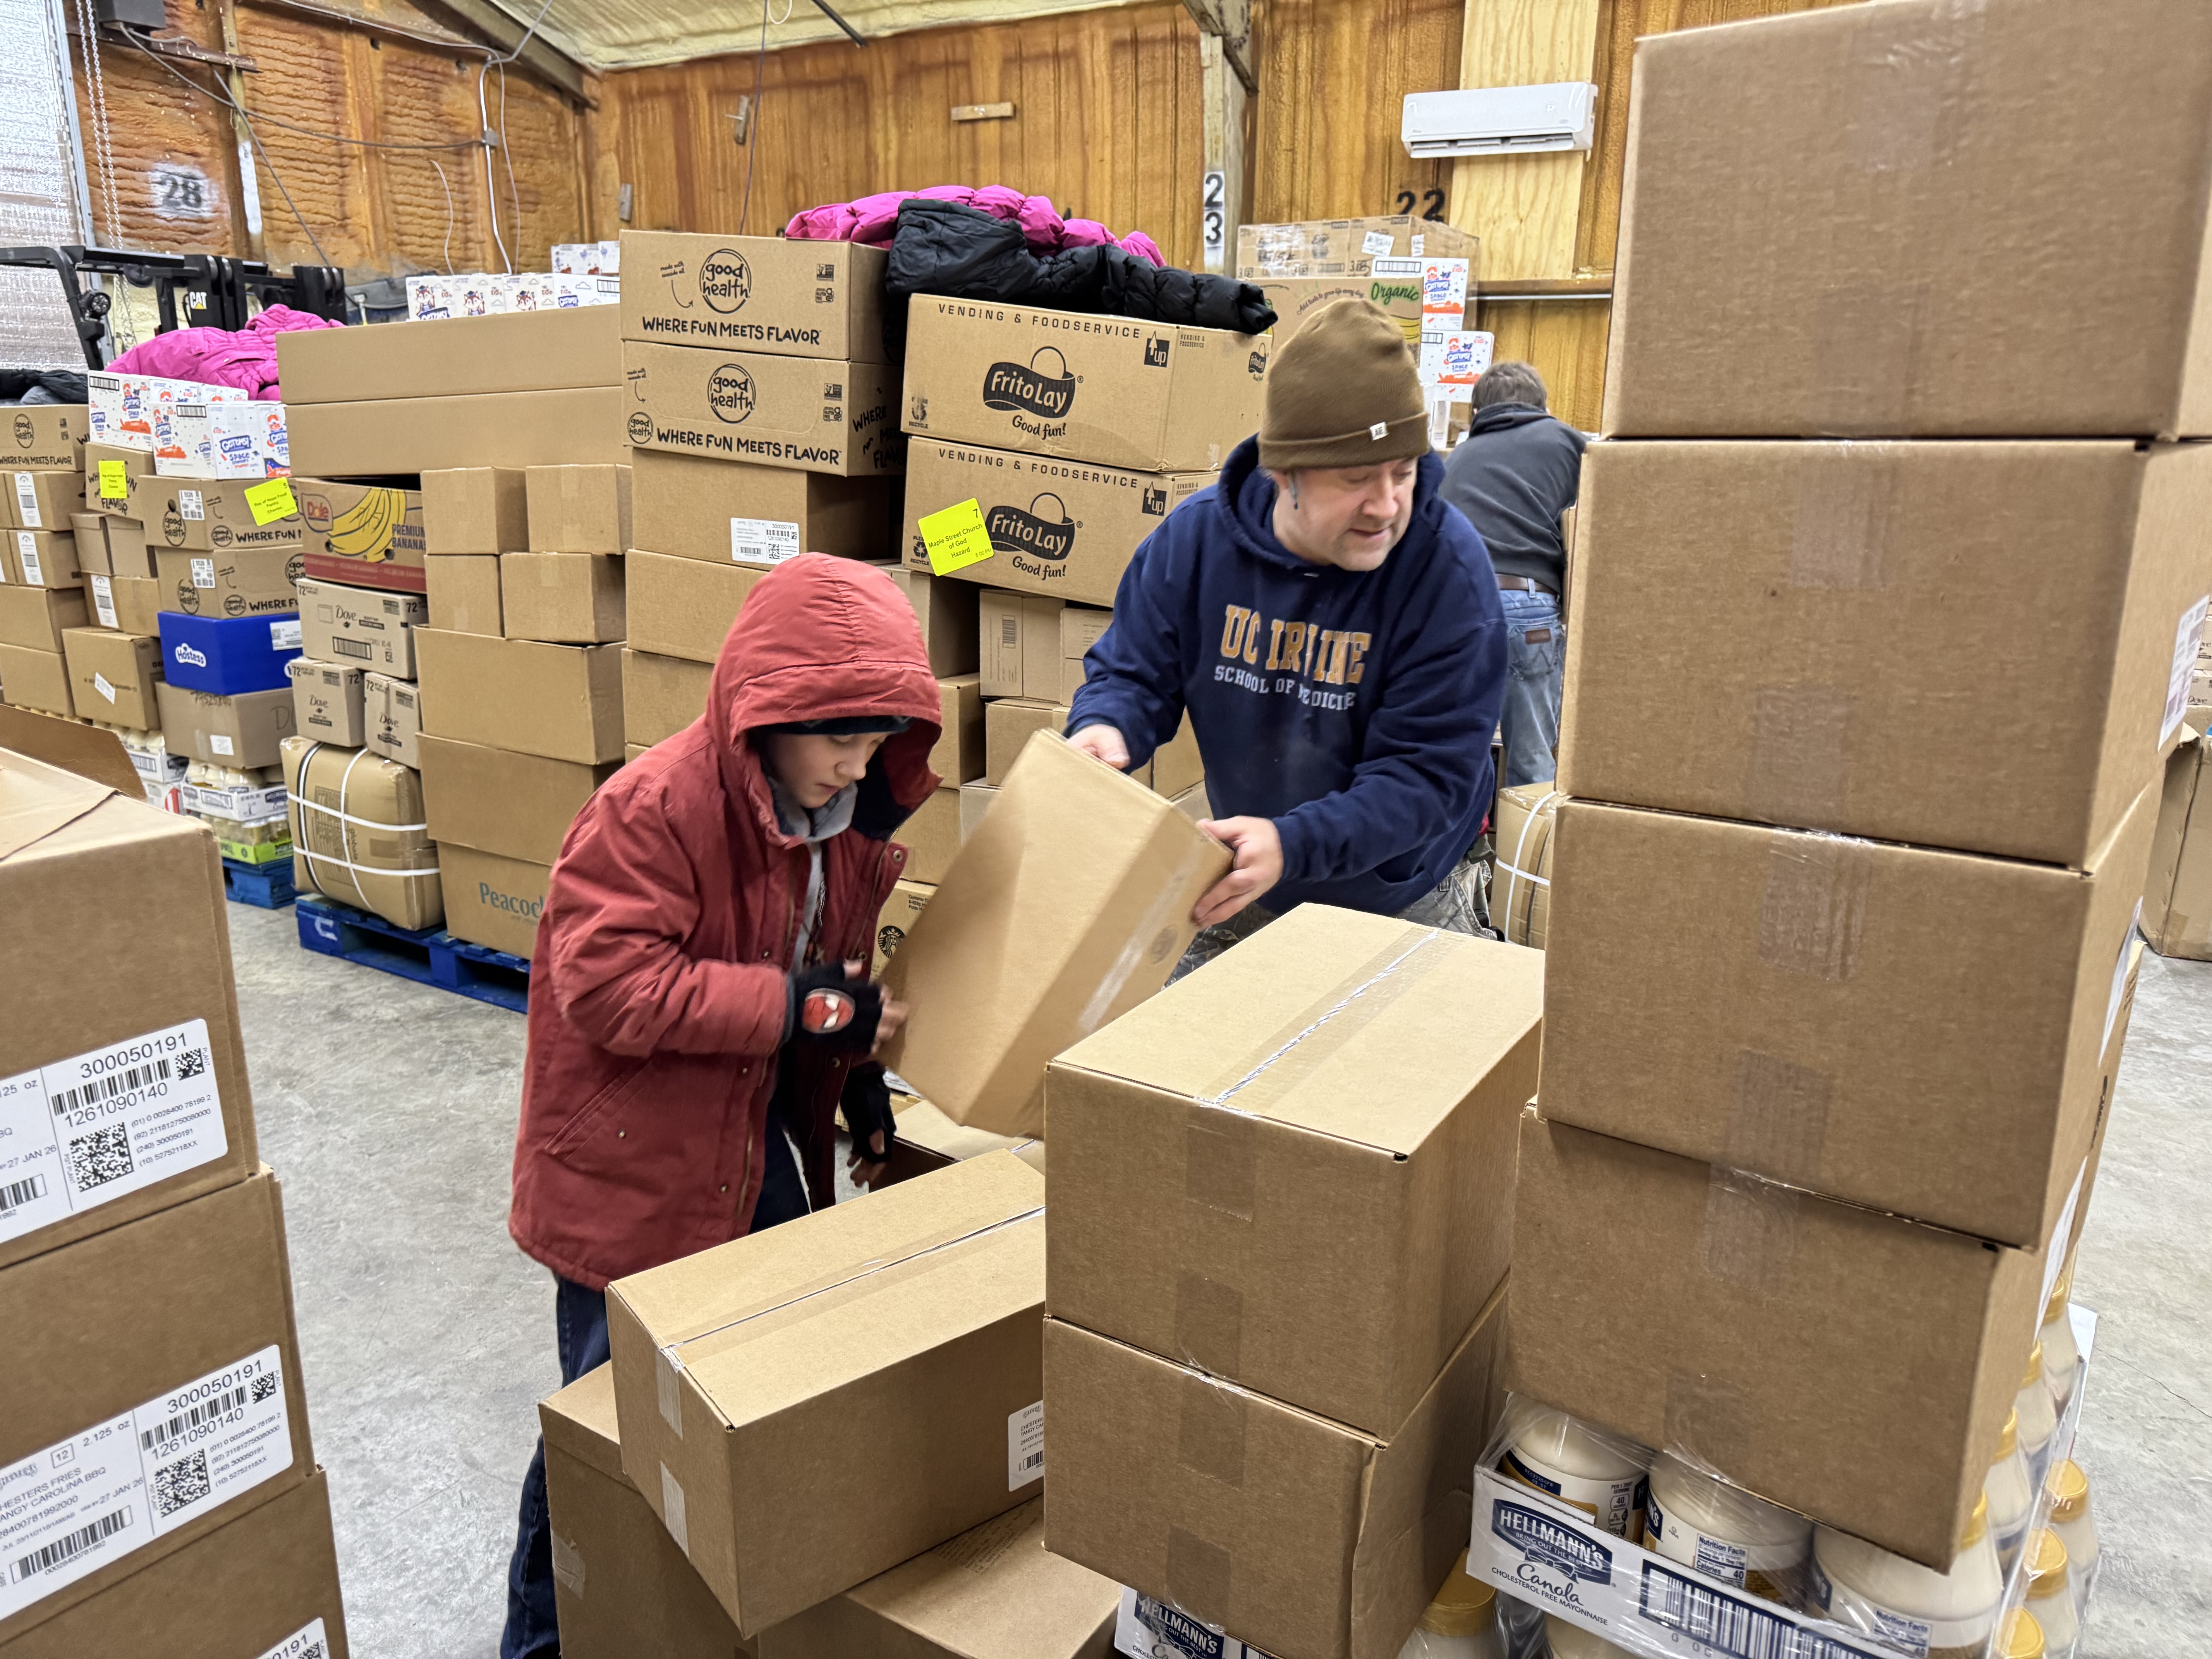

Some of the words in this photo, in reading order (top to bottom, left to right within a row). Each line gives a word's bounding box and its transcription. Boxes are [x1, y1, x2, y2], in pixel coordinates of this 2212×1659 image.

[161, 174, 203, 208] 28
[1396, 189, 1446, 222] 22
[660, 263, 673, 271] made
[674, 260, 685, 268] with
[706, 263, 744, 282] good
[703, 278, 749, 299] health
[1370, 282, 1420, 305] Organic
[190, 292, 207, 309] CAT
[939, 303, 1004, 321] VENDING
[1014, 314, 1022, 323] &
[1032, 315, 1141, 338] FOODSERVICE
[642, 316, 689, 333] WHERE
[691, 321, 718, 337] FUN
[720, 322, 764, 340] MEETS
[767, 326, 820, 345] FLAVOR
[1180, 340, 1205, 349] FOODSERVICE
[1154, 350, 1166, 366] up
[712, 375, 749, 393] good
[711, 393, 754, 410] health
[15, 421, 30, 432] good
[630, 418, 650, 428] good
[853, 406, 887, 433] WHERE
[908, 421, 929, 429] RECYCLE
[1012, 415, 1041, 438] Good
[1042, 422, 1067, 441] fun!
[15, 430, 34, 440] health
[629, 426, 652, 437] health
[658, 428, 704, 446] WHERE
[706, 434, 733, 452] FUN
[737, 438, 782, 458] MEETS
[785, 444, 840, 465] FLAVOR
[18, 456, 30, 464] FUN
[49, 456, 72, 464] FLAVOR
[229, 453, 250, 461] SPACE
[938, 448, 1003, 467] VENDING
[1013, 460, 1022, 470] &
[1031, 463, 1139, 489] FOODSERVICE
[101, 498, 127, 515] FLAVOR
[306, 502, 329, 518] Dole
[972, 508, 978, 519] 7
[1152, 500, 1164, 515] up
[165, 518, 182, 529] good
[165, 528, 185, 537] health
[213, 534, 232, 542] health
[236, 532, 275, 543] WHERE
[275, 530, 293, 540] FUN
[928, 538, 945, 548] Maple
[945, 531, 962, 542] Street
[962, 523, 983, 535] Church
[955, 538, 967, 546] God
[951, 546, 971, 558] Hazard
[1012, 555, 1041, 577] Good
[1042, 563, 1066, 581] fun!
[179, 586, 194, 595] good
[299, 586, 306, 595] 72
[180, 596, 198, 606] health
[249, 600, 288, 611] WHERE
[406, 602, 418, 613] 72
[336, 605, 356, 620] Dove
[1220, 604, 1261, 665] UC
[177, 649, 205, 665] Hostess
[292, 666, 301, 677] 72
[349, 674, 359, 685] 72
[1214, 665, 1269, 694] SCHOOL
[1275, 678, 1295, 694] OF
[366, 680, 374, 691] 72
[309, 695, 329, 708] Dove
[379, 713, 399, 727] Dove
[479, 882, 544, 919] Peacoc
[81, 1032, 188, 1080] 300050191
[202, 1047, 210, 1066] PLANT
[64, 1082, 169, 1128] 1261090140
[131, 1118, 146, 1128] (01)
[153, 1104, 184, 1119] 0028400
[184, 1096, 205, 1109] 78199
[134, 1130, 148, 1141] (92)
[136, 1142, 155, 1154] (240)
[156, 1128, 193, 1146] 300050191
[8, 1157, 19, 1169] 27
[22, 1149, 43, 1162] JAN
[43, 1144, 57, 1156] 26
[139, 1157, 154, 1167] (10)
[155, 1140, 198, 1160] 52752118XX
[167, 1359, 262, 1414] 300050191
[151, 1407, 244, 1460] 1261090140
[210, 1443, 223, 1453] (01)
[229, 1425, 256, 1443] 0028400
[257, 1415, 276, 1429] 78199
[1020, 1427, 1036, 1437] TANGY
[56, 1450, 69, 1461] 12
[82, 1427, 113, 1447] 2.125
[231, 1445, 264, 1467] 300050191
[50, 1467, 82, 1487] FRIES
[31, 1477, 84, 1507] CAROLINA
[84, 1467, 106, 1482] BBQ
[99, 1493, 111, 1504] 27
[113, 1483, 131, 1498] JAN
[132, 1477, 144, 1488] 26
[1616, 1496, 1625, 1504] 40
[1500, 1509, 1604, 1570] HELLMANN'S
[1698, 1536, 1726, 1553] Nutrition
[1727, 1547, 1746, 1557] Facts
[1538, 1541, 1552, 1551] OUT
[1554, 1547, 1567, 1558] THE
[1696, 1560, 1722, 1575] Calories
[1733, 1570, 1744, 1580] 40
[1516, 1563, 1584, 1606] Canola
[1491, 1567, 1540, 1595] CHOLESTEROL
[1541, 1591, 1558, 1603] FREE
[1559, 1598, 1608, 1626] MAYONNAISE
[1141, 1595, 1218, 1654] HELLMANN'S
[1168, 1627, 1179, 1637] OUT
[1180, 1634, 1190, 1644] THE
